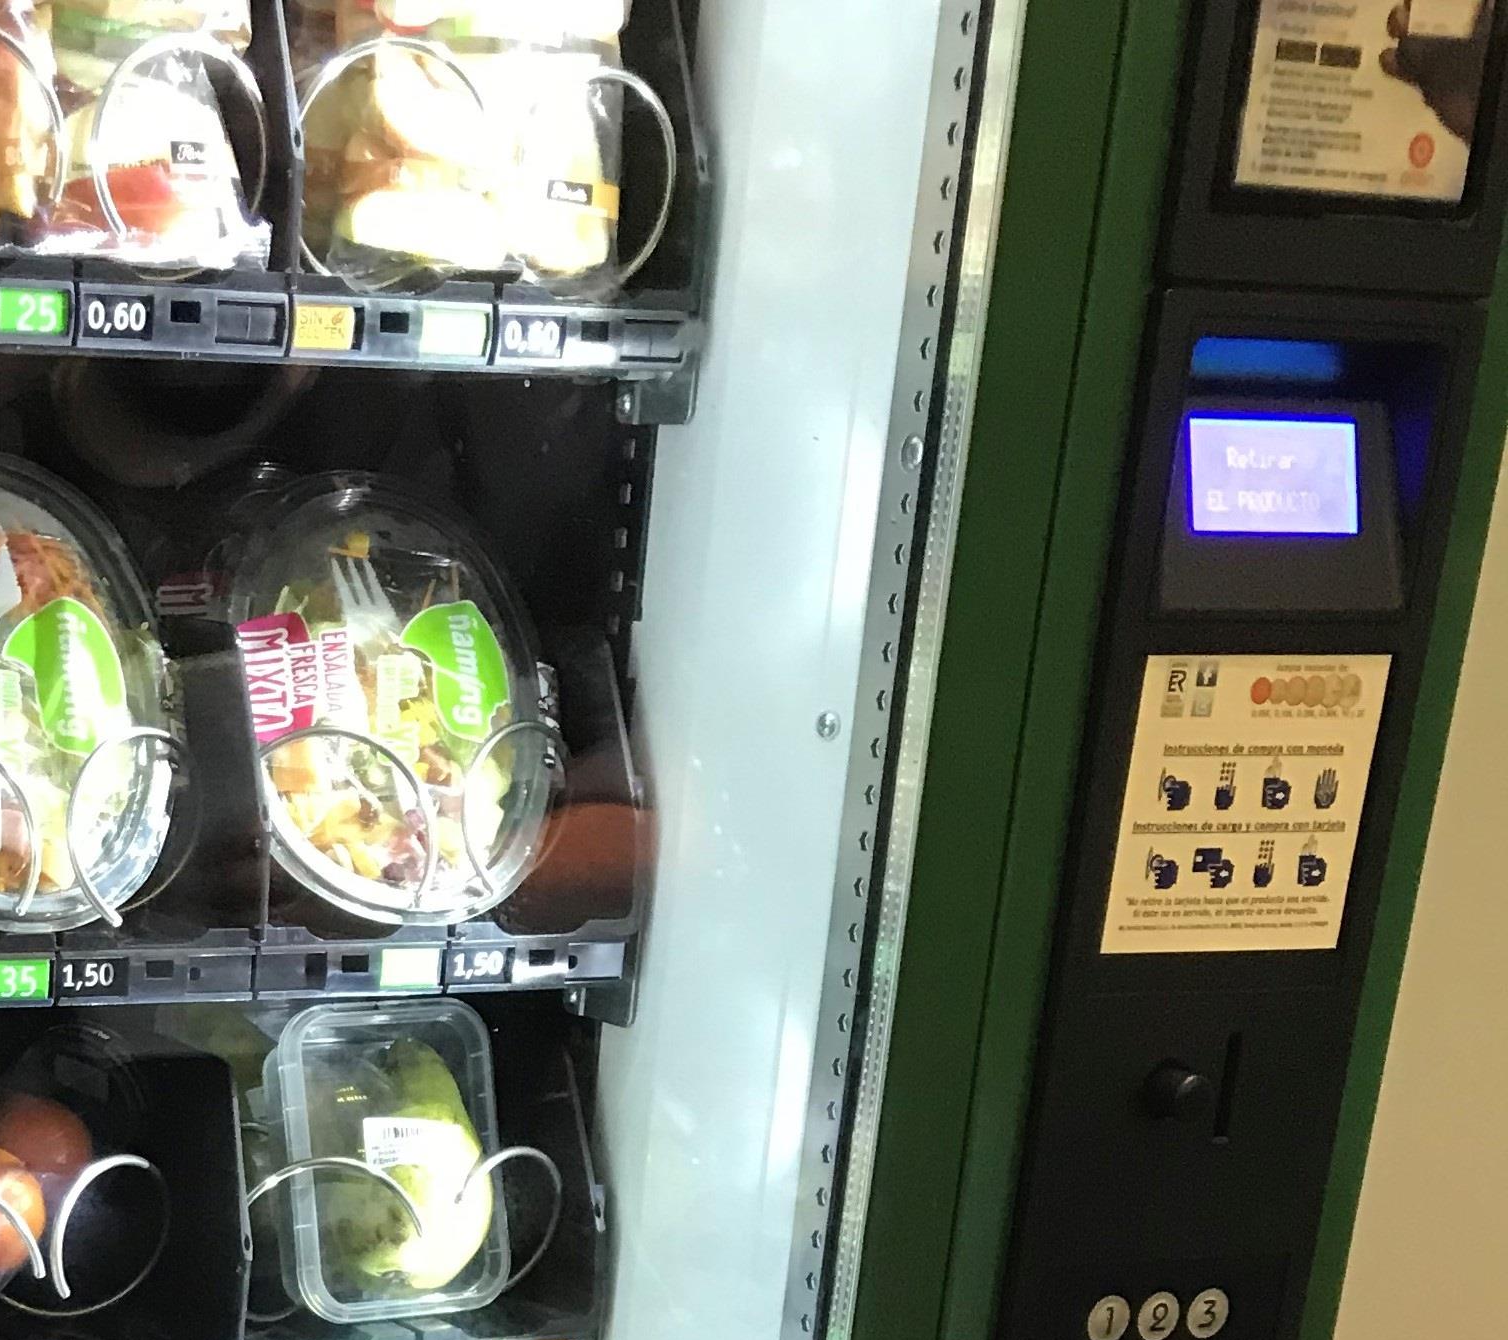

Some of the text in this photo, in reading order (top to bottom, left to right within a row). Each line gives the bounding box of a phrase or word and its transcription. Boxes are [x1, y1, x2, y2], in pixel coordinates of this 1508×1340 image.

[17, 295, 56, 332] 25
[88, 301, 146, 334] 0,60
[299, 308, 322, 325] SIN
[240, 628, 293, 735] MIXTA
[292, 642, 317, 707] FRESCA
[1164, 743, 1345, 757] Instrucciones de compra con moneda
[1132, 821, 1197, 833] Instrucciones
[1200, 821, 1214, 833] de
[1292, 822, 1310, 833] con
[62, 961, 115, 989] 1,50
[454, 950, 504, 977] 1,50
[2, 964, 39, 999] 35
[1107, 1299, 1216, 1336] 1 2 3
